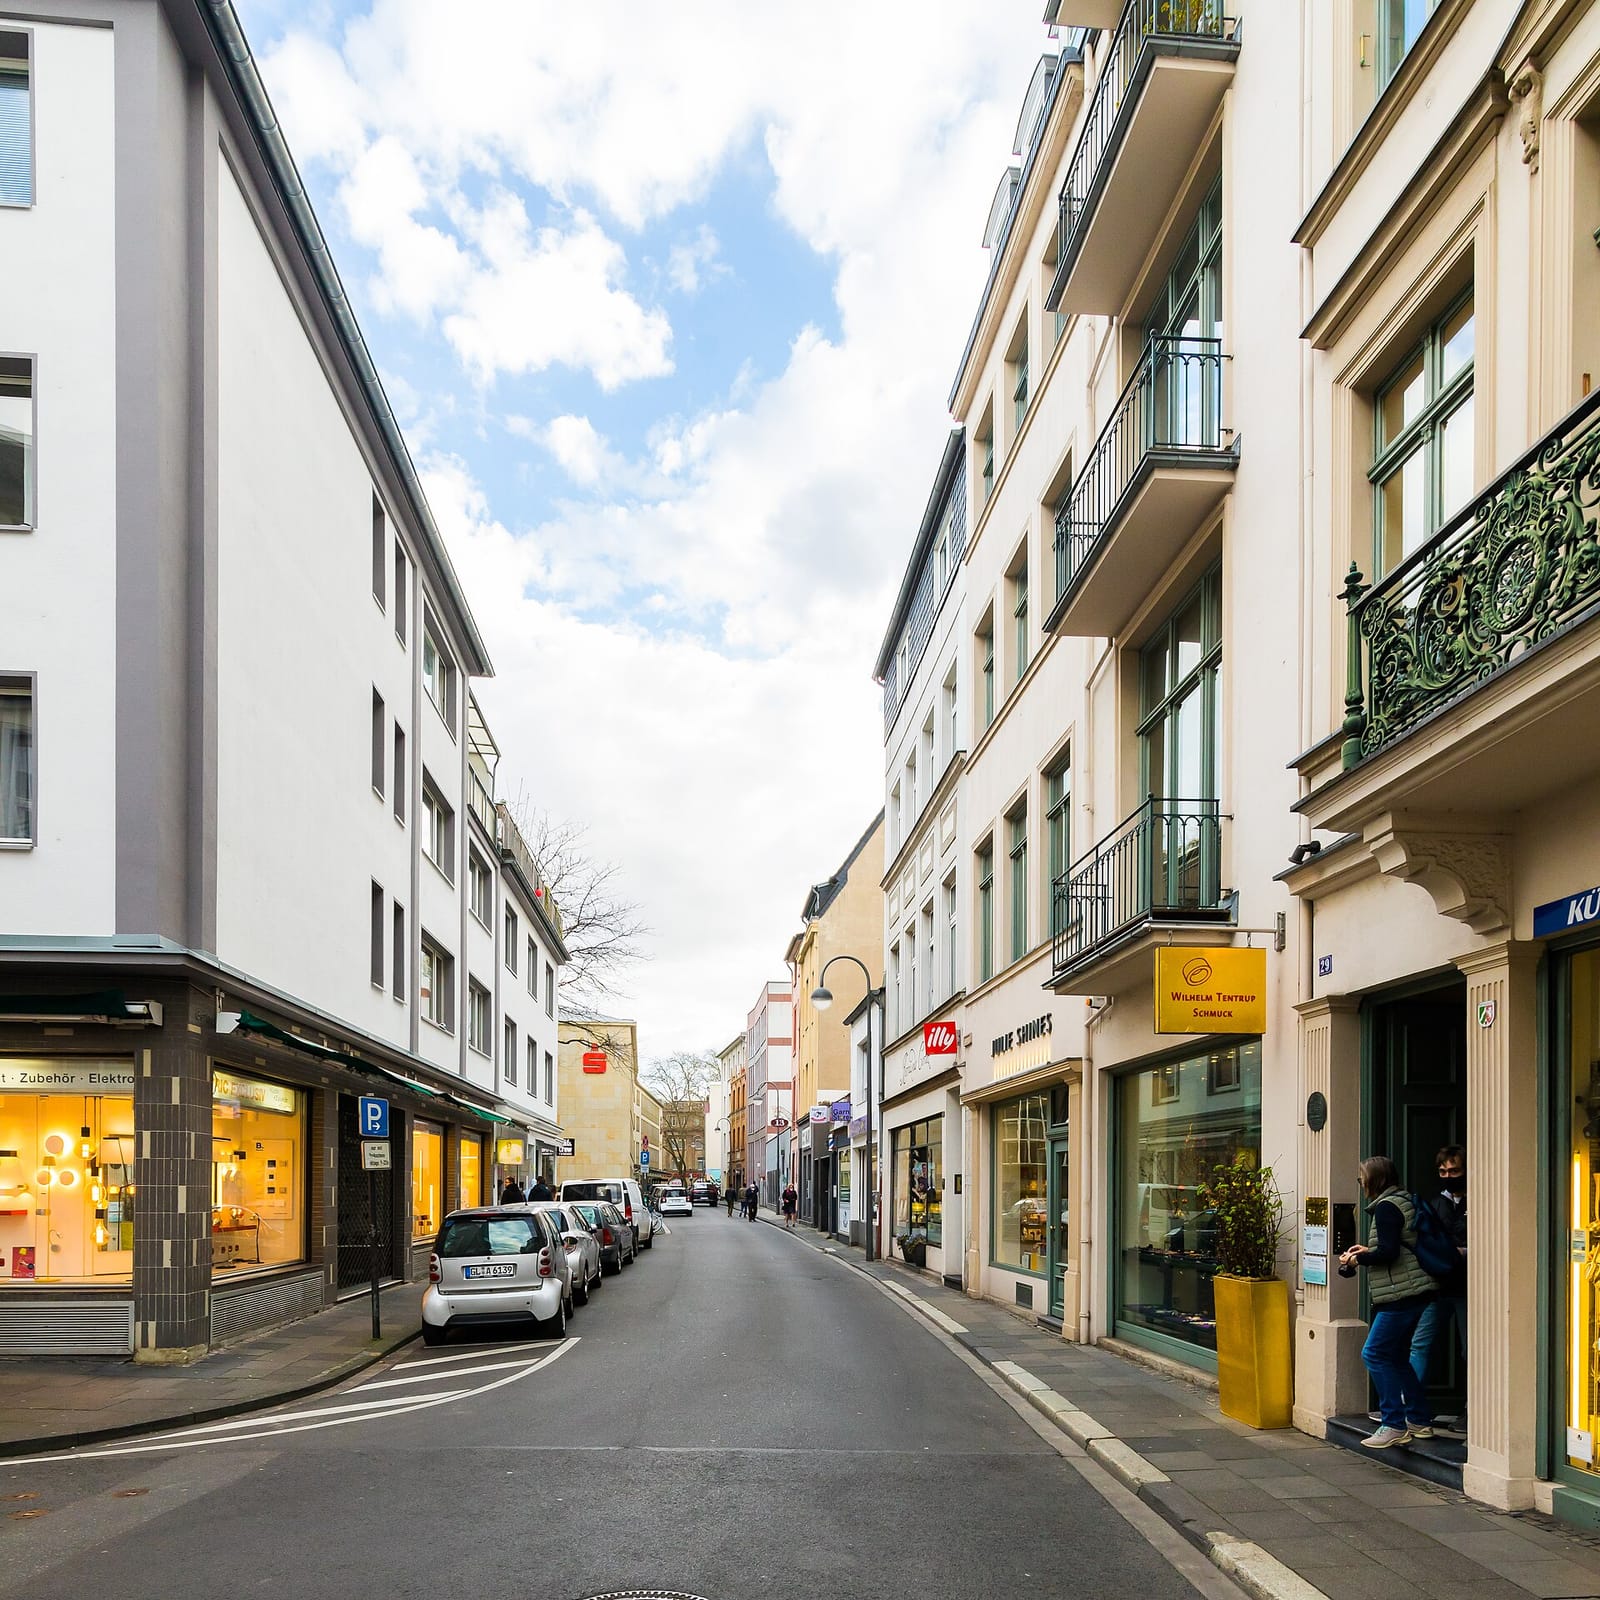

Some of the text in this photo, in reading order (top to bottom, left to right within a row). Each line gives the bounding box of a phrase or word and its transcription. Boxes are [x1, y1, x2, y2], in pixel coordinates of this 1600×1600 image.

[1567, 888, 1600, 925] KÜ
[1320, 958, 1330, 973] 29
[1171, 992, 1256, 1002] WILHELM TENTRUP
[1193, 1008, 1233, 1017] SCHMUCK
[927, 1026, 955, 1051] illy
[991, 1013, 1052, 1058] JULIE SHINES
[20, 1073, 76, 1083] Zubehör
[89, 1073, 135, 1083] Elektro
[367, 1103, 382, 1130] P
[492, 1266, 513, 1275] 6139
